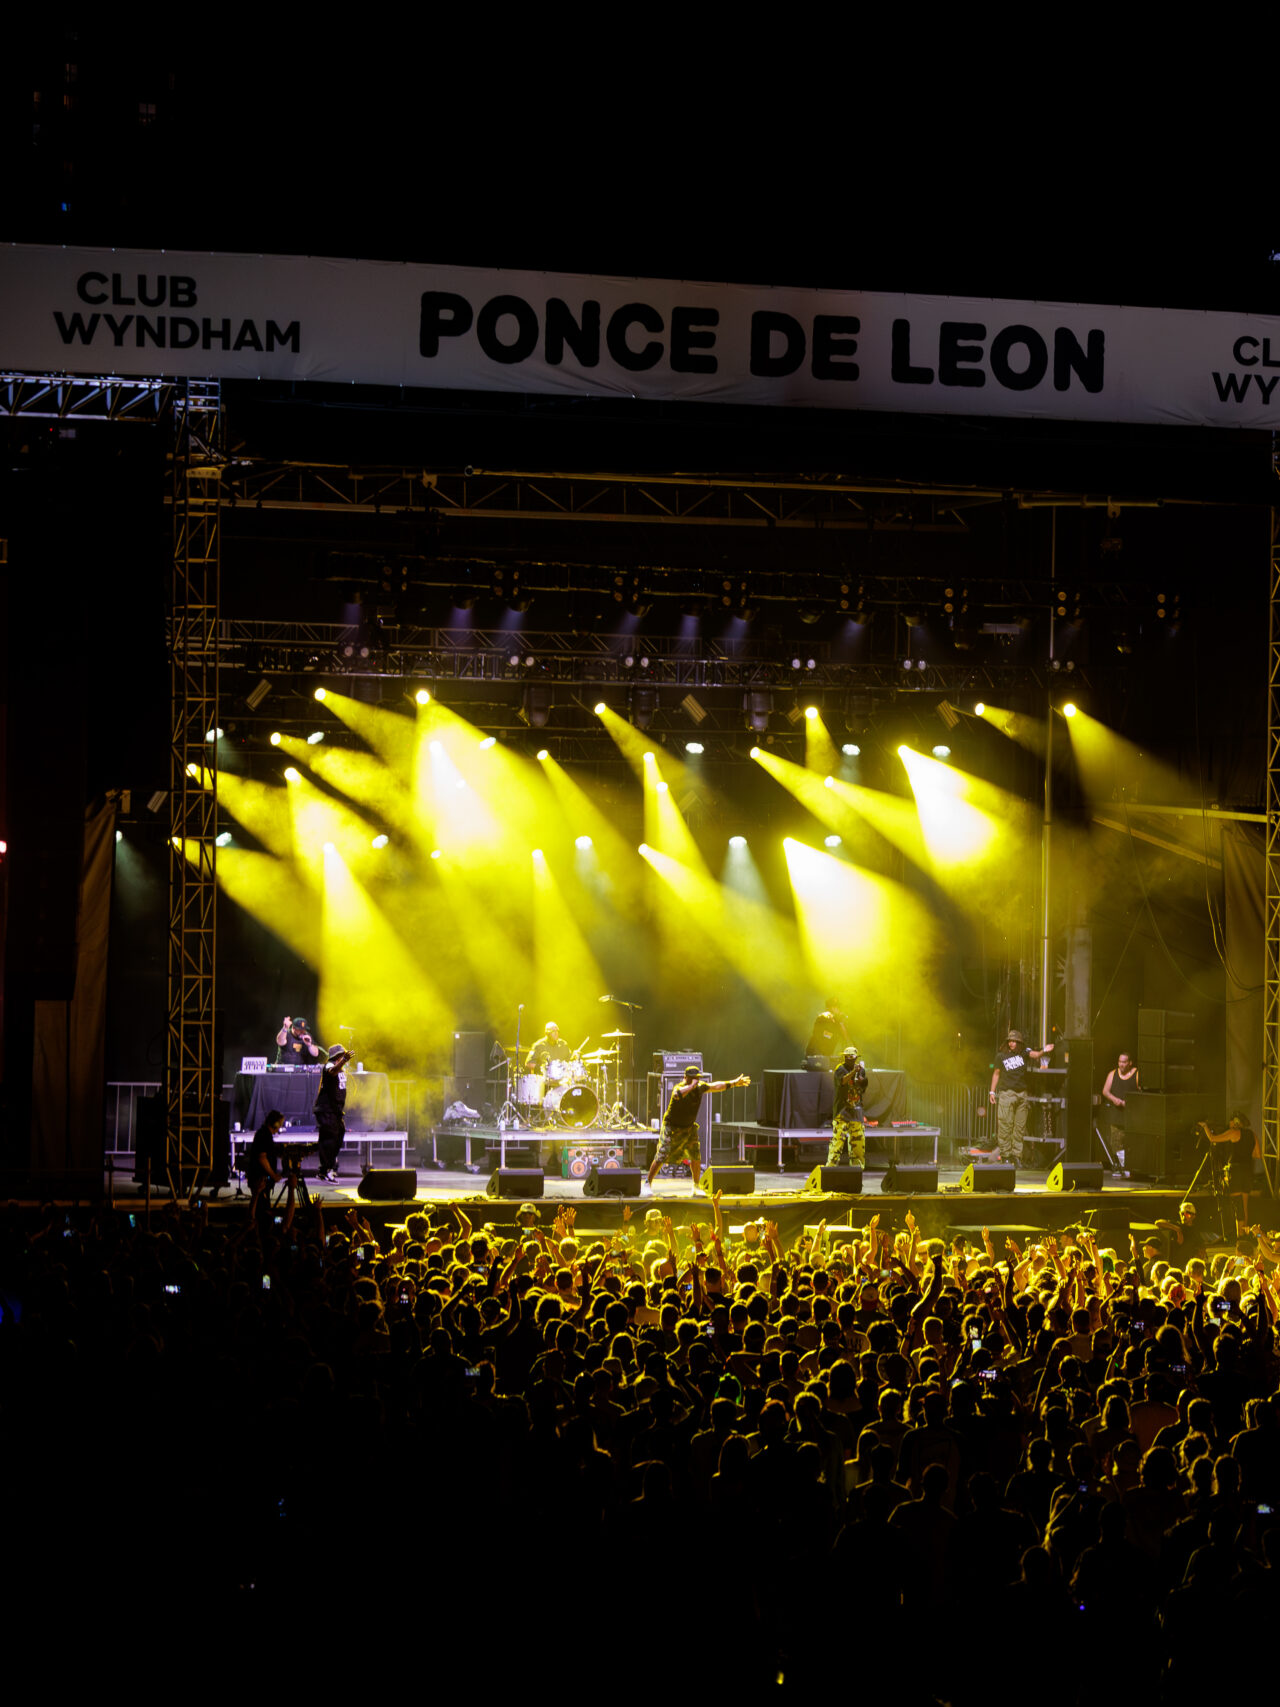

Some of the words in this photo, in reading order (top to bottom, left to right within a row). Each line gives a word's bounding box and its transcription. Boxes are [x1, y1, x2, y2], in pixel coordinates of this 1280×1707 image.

[76, 270, 198, 309] CLUB
[52, 311, 301, 354] WYNDHAM
[419, 290, 720, 375] PONCE
[749, 310, 861, 382] DE
[890, 318, 1106, 394] LEON
